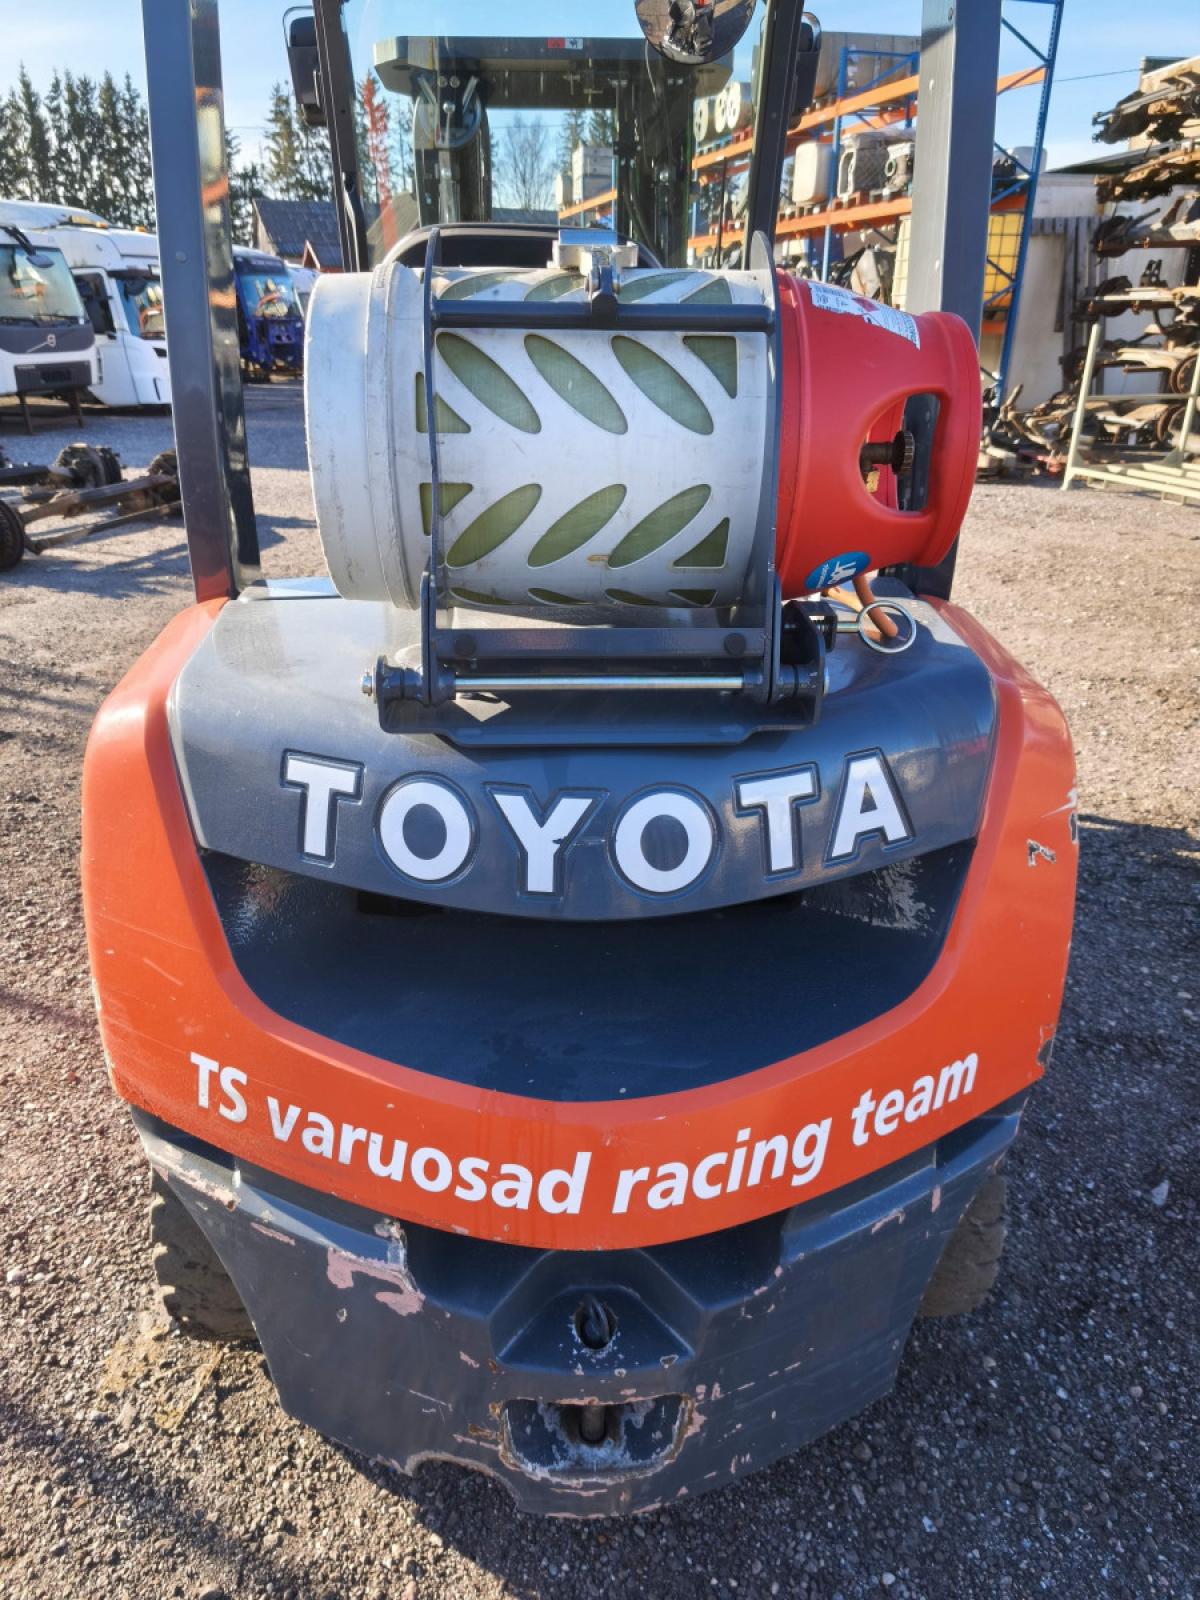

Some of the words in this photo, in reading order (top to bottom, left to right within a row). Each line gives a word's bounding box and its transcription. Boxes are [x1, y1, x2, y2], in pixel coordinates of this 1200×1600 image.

[286, 755, 908, 893] TOYOTA
[190, 1051, 248, 1123] TS
[267, 1096, 592, 1214] varuosad
[612, 1119, 833, 1214] racing
[851, 1052, 978, 1146] team
